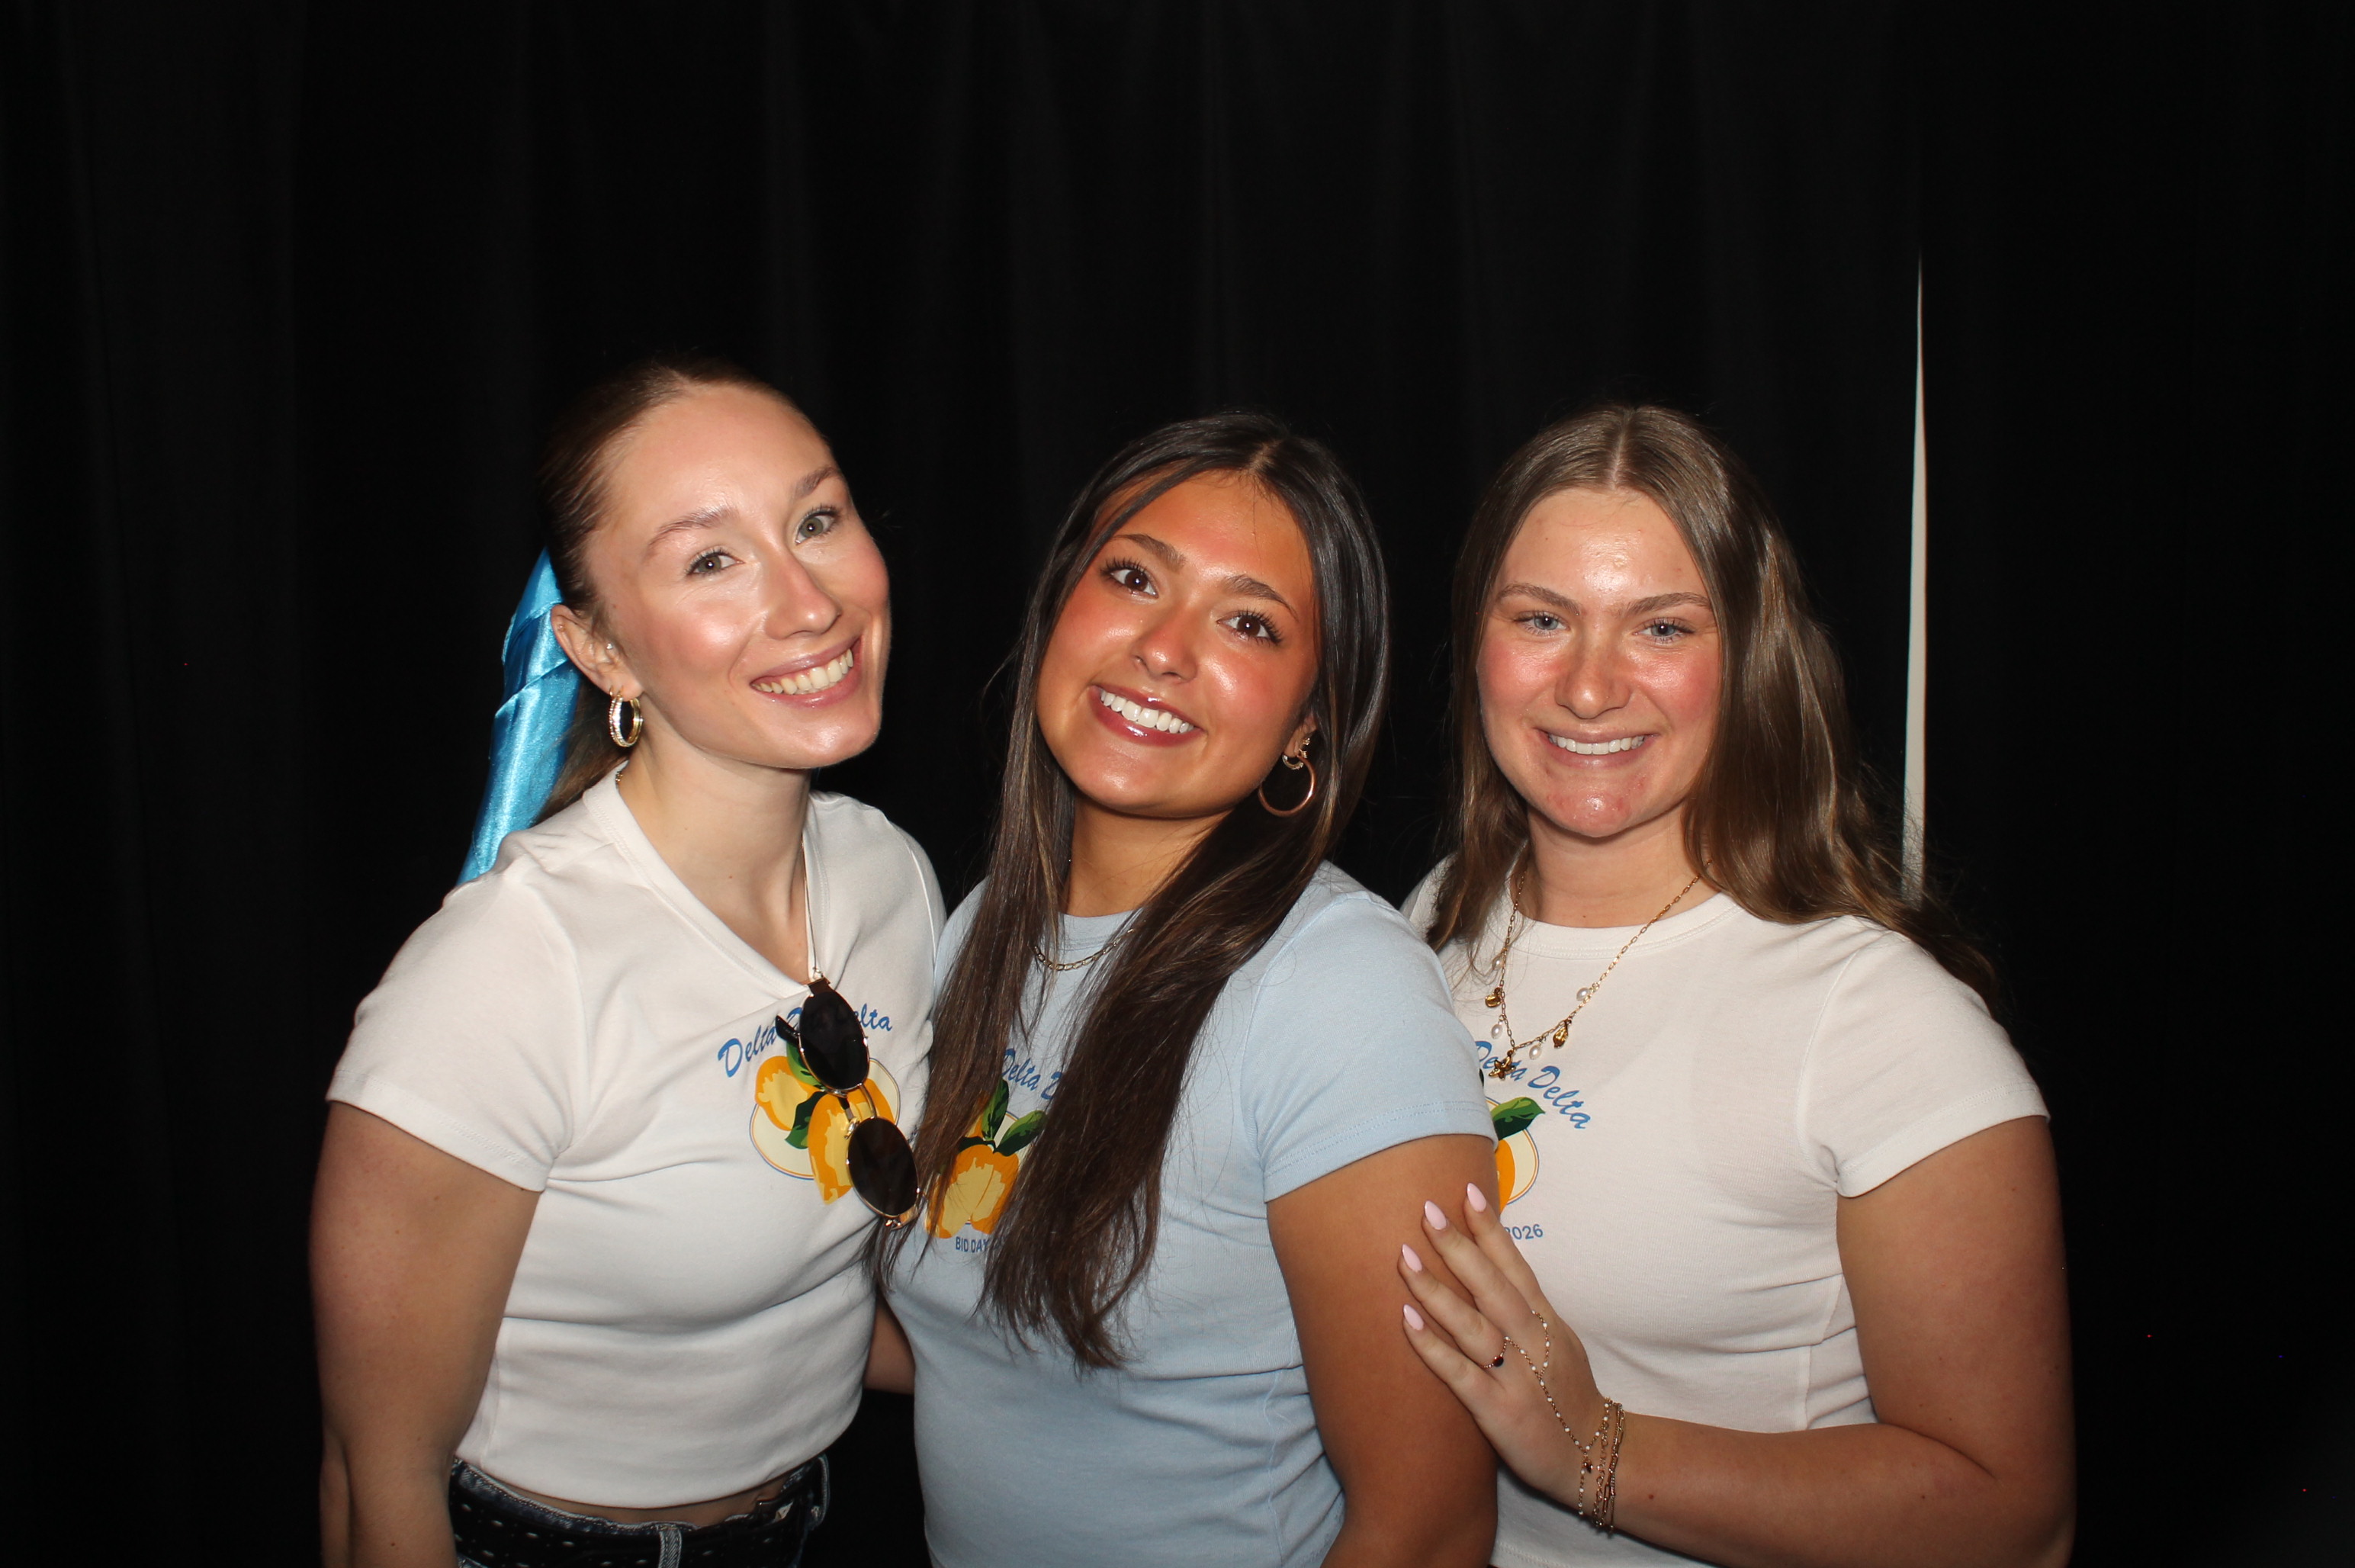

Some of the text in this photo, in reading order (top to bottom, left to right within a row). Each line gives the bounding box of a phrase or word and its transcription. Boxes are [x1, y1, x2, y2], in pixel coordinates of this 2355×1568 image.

[718, 1024, 778, 1078] Delta
[1001, 1047, 1041, 1091] Delta
[1527, 1065, 1591, 1129] Delta
[956, 1235, 990, 1253] BID DAY
